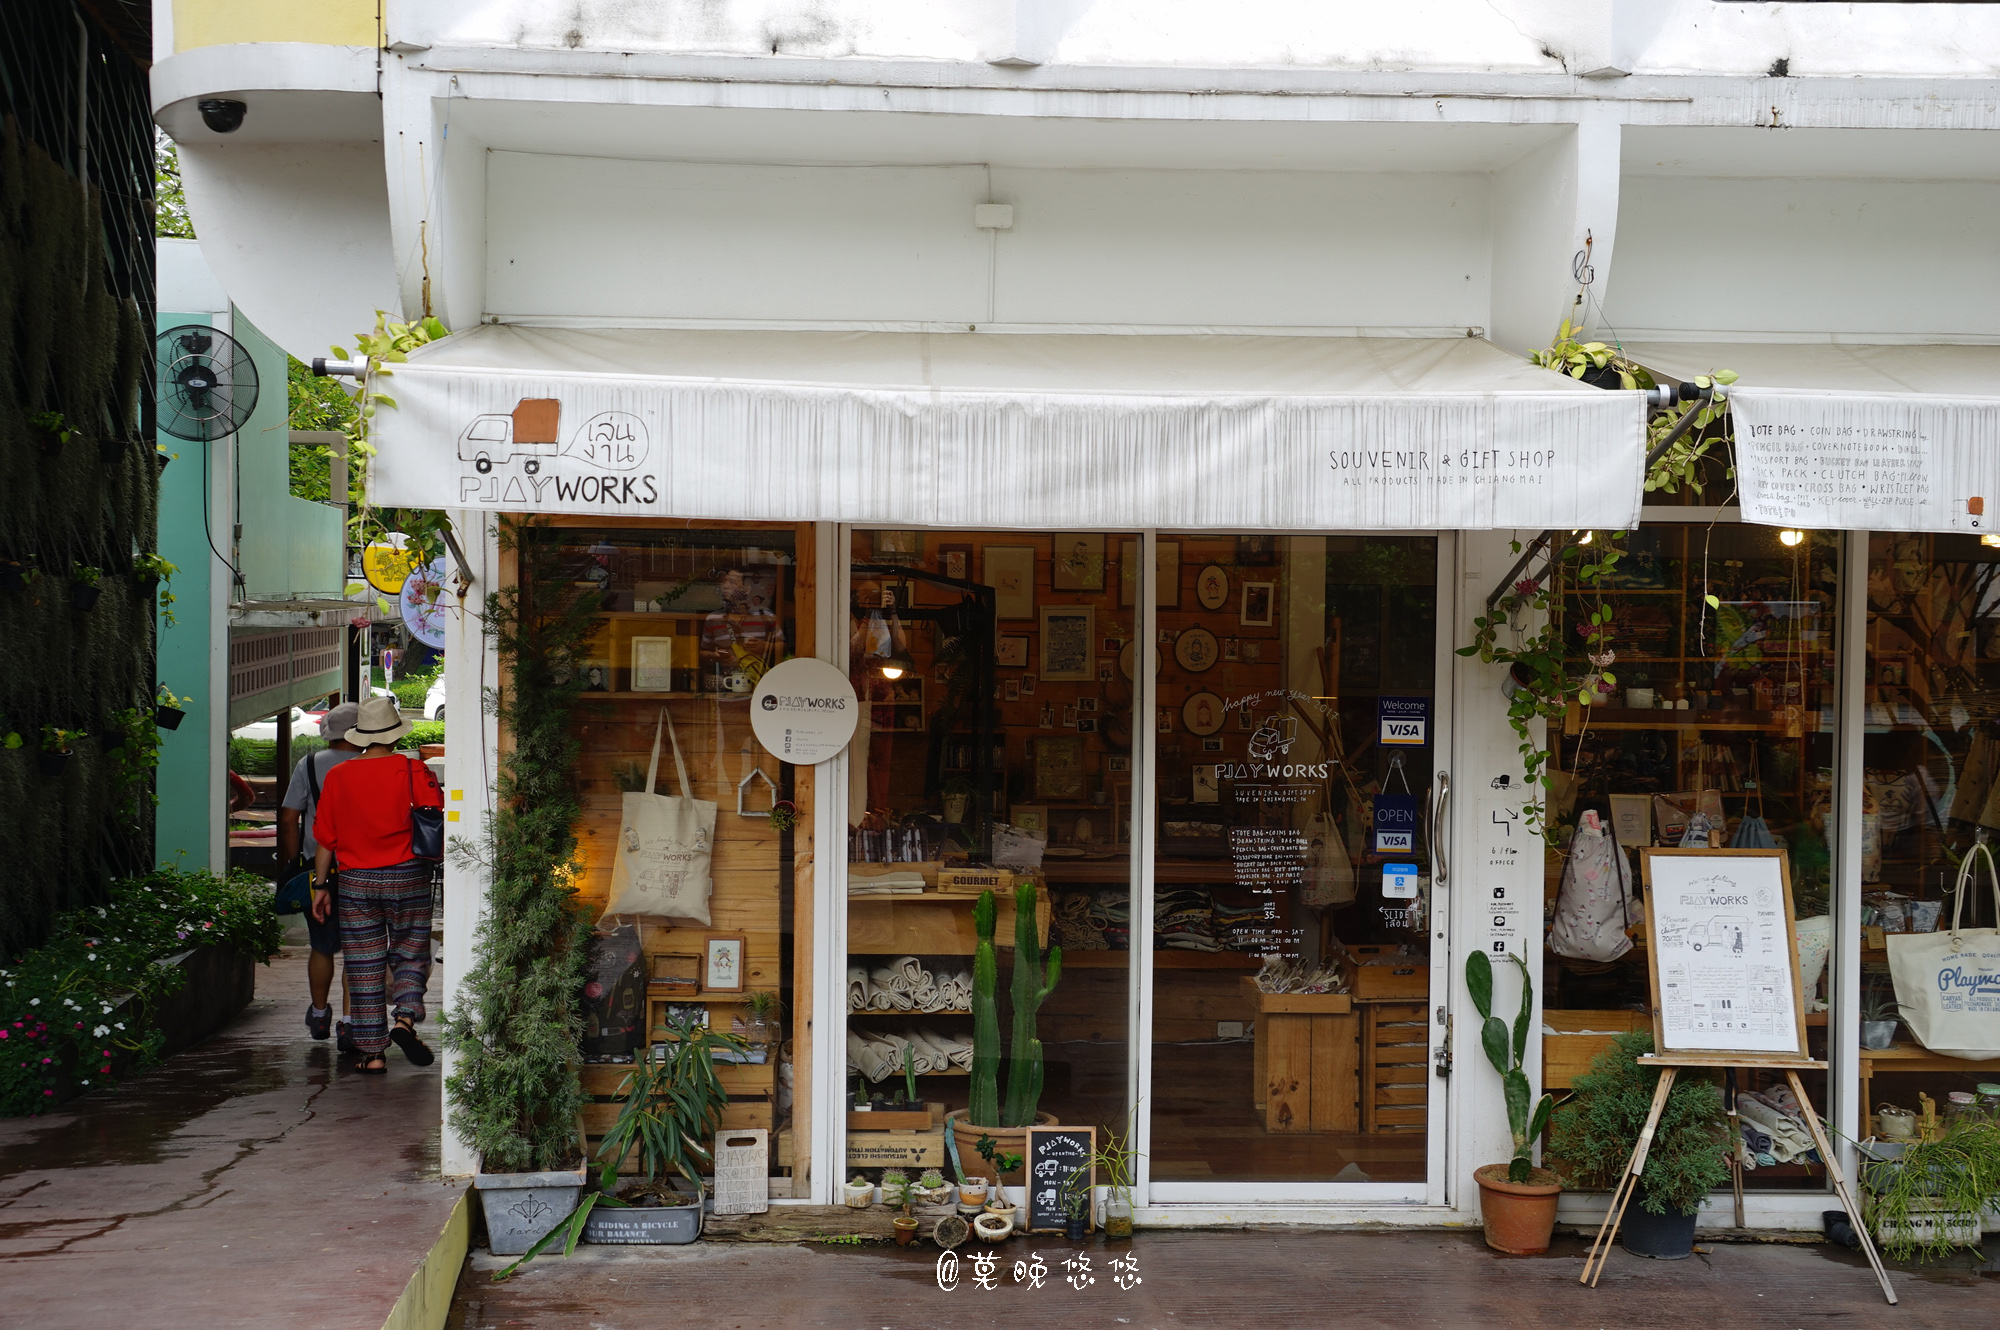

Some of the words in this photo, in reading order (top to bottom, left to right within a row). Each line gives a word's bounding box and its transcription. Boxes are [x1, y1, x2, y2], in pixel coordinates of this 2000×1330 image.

[1779, 425, 1796, 435] BAG
[1810, 426, 1831, 435] COIN
[1837, 427, 1853, 435] BAG
[1863, 428, 1917, 439] DRAWSTRING
[1330, 450, 1429, 470] SOUVENIR
[1442, 454, 1451, 466] &
[1460, 449, 1499, 469] GIFT
[1508, 450, 1555, 468] SHOP
[1795, 456, 1808, 465] BAG
[1782, 469, 1807, 478] PACK
[1821, 470, 1865, 480] CLUTCH
[1874, 471, 1895, 481] BAG
[1343, 477, 1361, 486] ALL
[1369, 476, 1418, 485] PRODUCTS
[1426, 476, 1454, 485] MADE
[1459, 475, 1468, 484] IN
[1771, 482, 1796, 492] COVER
[1805, 482, 1834, 493] CROSS
[1839, 484, 1857, 493] BAG
[1870, 484, 1913, 494] WRISTLET
[1818, 496, 1838, 505] KEY
[1221, 692, 1262, 713] happy
[1313, 700, 1339, 720] 2017
[1382, 701, 1425, 710] Welcome
[1387, 724, 1419, 736] VISA
[1377, 808, 1414, 822] OPEN
[1382, 836, 1408, 846] VISA
[954, 876, 999, 886] GOURMET
[1264, 911, 1274, 919] 35
[1384, 911, 1409, 920] SLIDE
[1942, 954, 1958, 962] HOME
[716, 1192, 748, 1204] MADE
[641, 1221, 679, 1229] BICYCLE
[505, 1226, 547, 1236] Jardi
